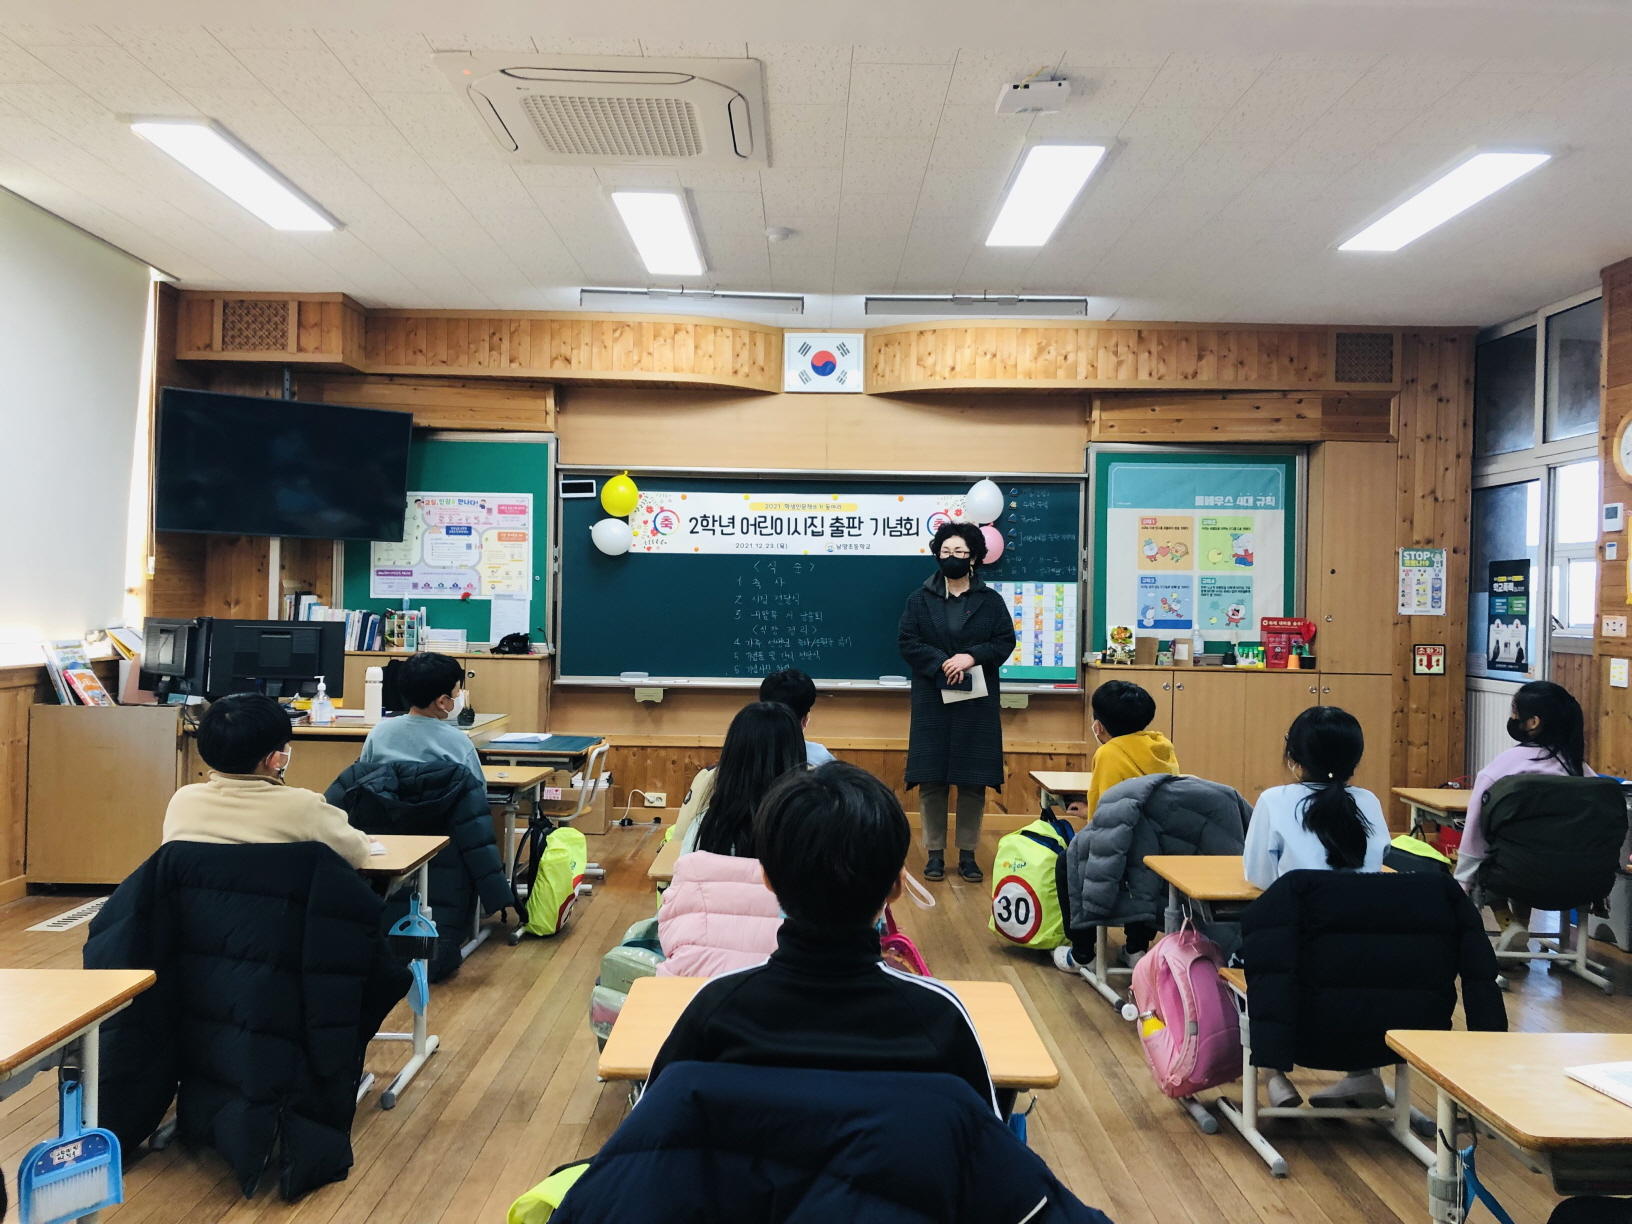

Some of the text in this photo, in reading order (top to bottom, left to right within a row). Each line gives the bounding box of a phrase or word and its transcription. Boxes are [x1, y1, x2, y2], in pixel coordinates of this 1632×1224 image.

[1235, 494, 1254, 507] 4대
[1255, 494, 1276, 507] 규칙
[660, 515, 674, 530] 축
[688, 513, 920, 538] 2학년 어린이시집 출판 기념회
[1403, 551, 1431, 560] STOP
[1417, 647, 1442, 655] 소화기
[996, 895, 1031, 926] 30
